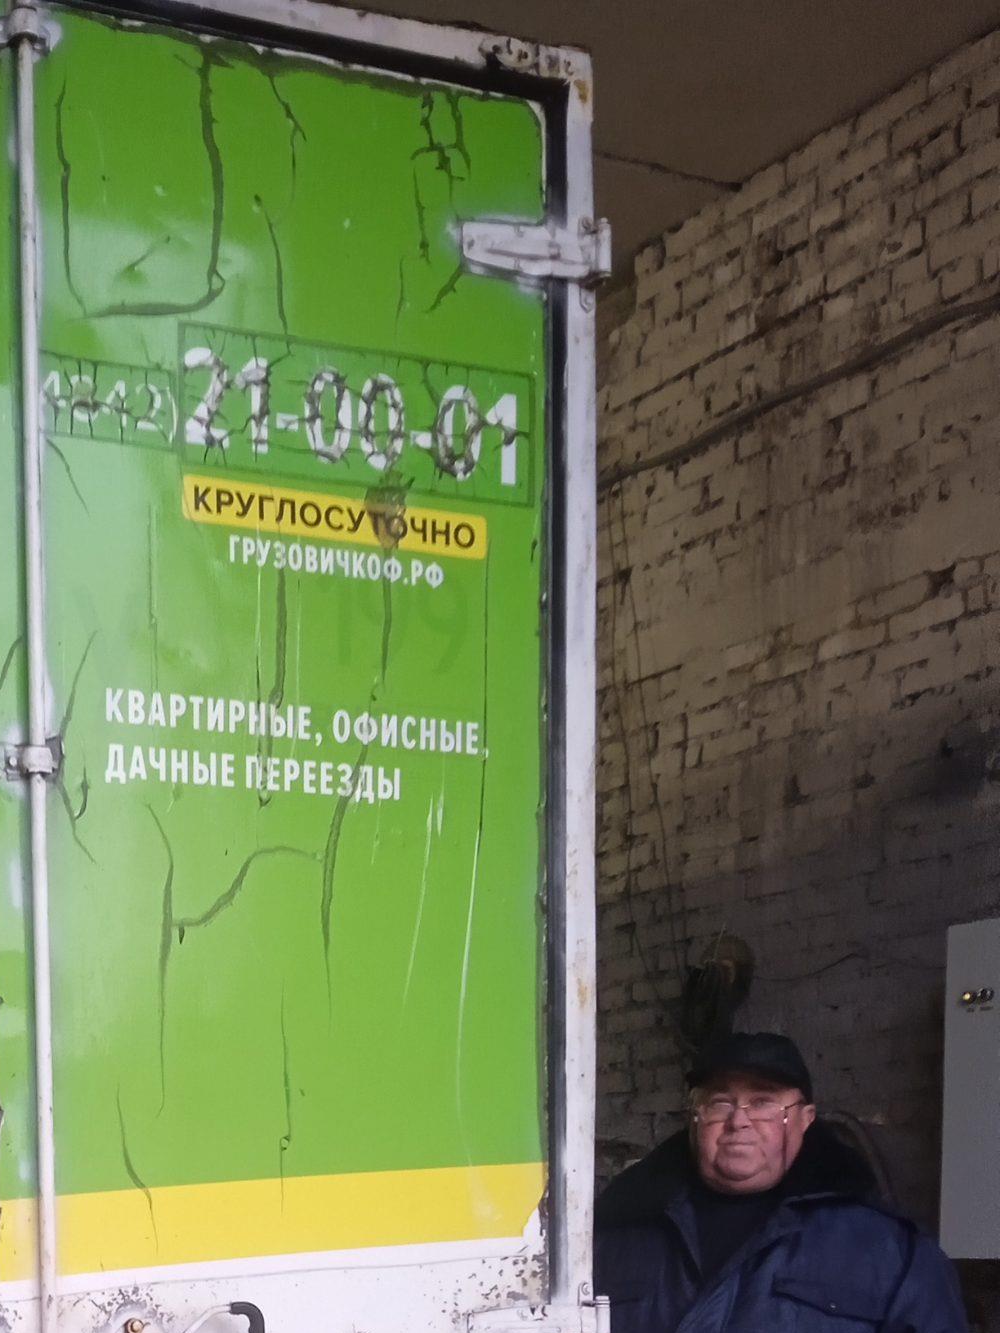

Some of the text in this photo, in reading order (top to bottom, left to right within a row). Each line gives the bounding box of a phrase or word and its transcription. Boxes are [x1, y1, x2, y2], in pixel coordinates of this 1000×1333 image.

[183, 346, 518, 486] 21-00-01
[193, 485, 477, 549] КРУГЛОСУТОЧНО
[229, 533, 445, 589] ГРУЗОВИЧКОФ.РФ
[104, 687, 323, 747] КВАРТИРНЫЕ,
[104, 743, 401, 804] ДАЧНЫЕ ПЕРЕЕЗДЫ
